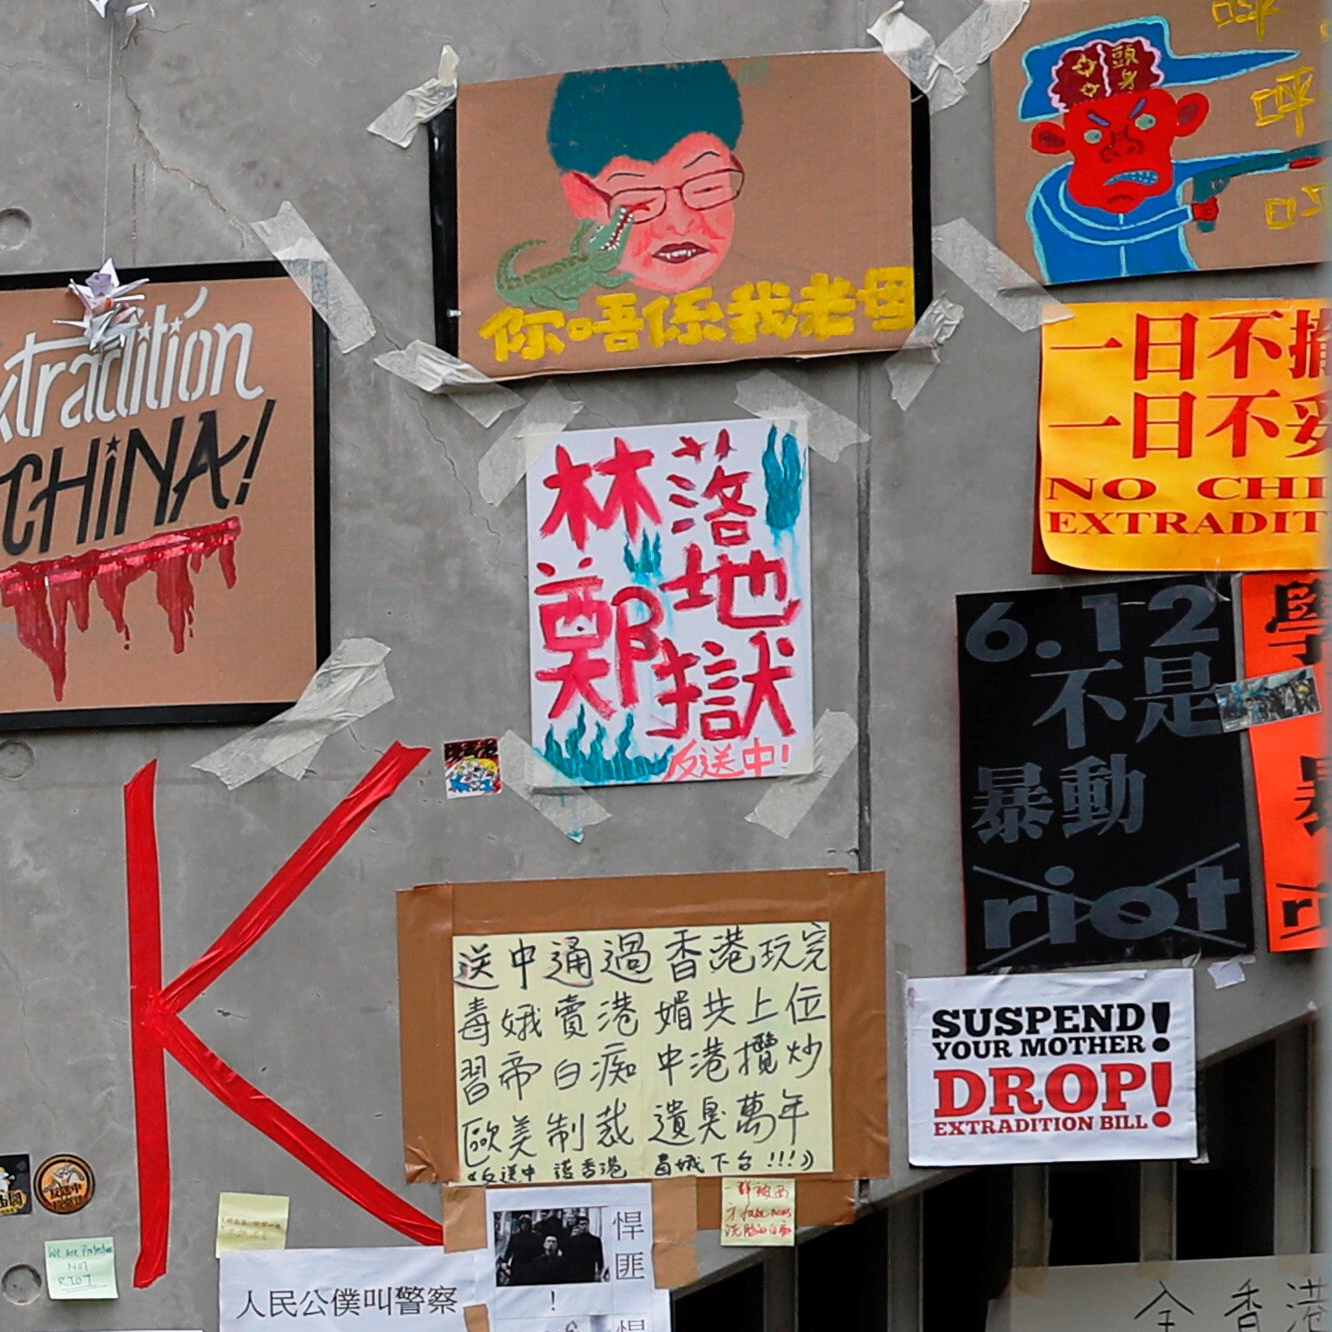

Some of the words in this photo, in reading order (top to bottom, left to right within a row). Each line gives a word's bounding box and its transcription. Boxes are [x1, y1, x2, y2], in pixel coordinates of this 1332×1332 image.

[1046, 477, 1157, 501] NO
[965, 584, 1220, 663] 6.12
[1031, 651, 1224, 750] 不是
[971, 754, 1147, 844] 暴動
[933, 1039, 1013, 1060] YOUR
[1021, 1035, 1146, 1057] MOTHER
[934, 1061, 1172, 1128] DROP!
[935, 1115, 1094, 1136] EXTRADITION
[1100, 1114, 1148, 1131] BILL
[613, 1210, 646, 1283] 悍匪
[235, 1285, 459, 1319] 人民公僕叫警察
